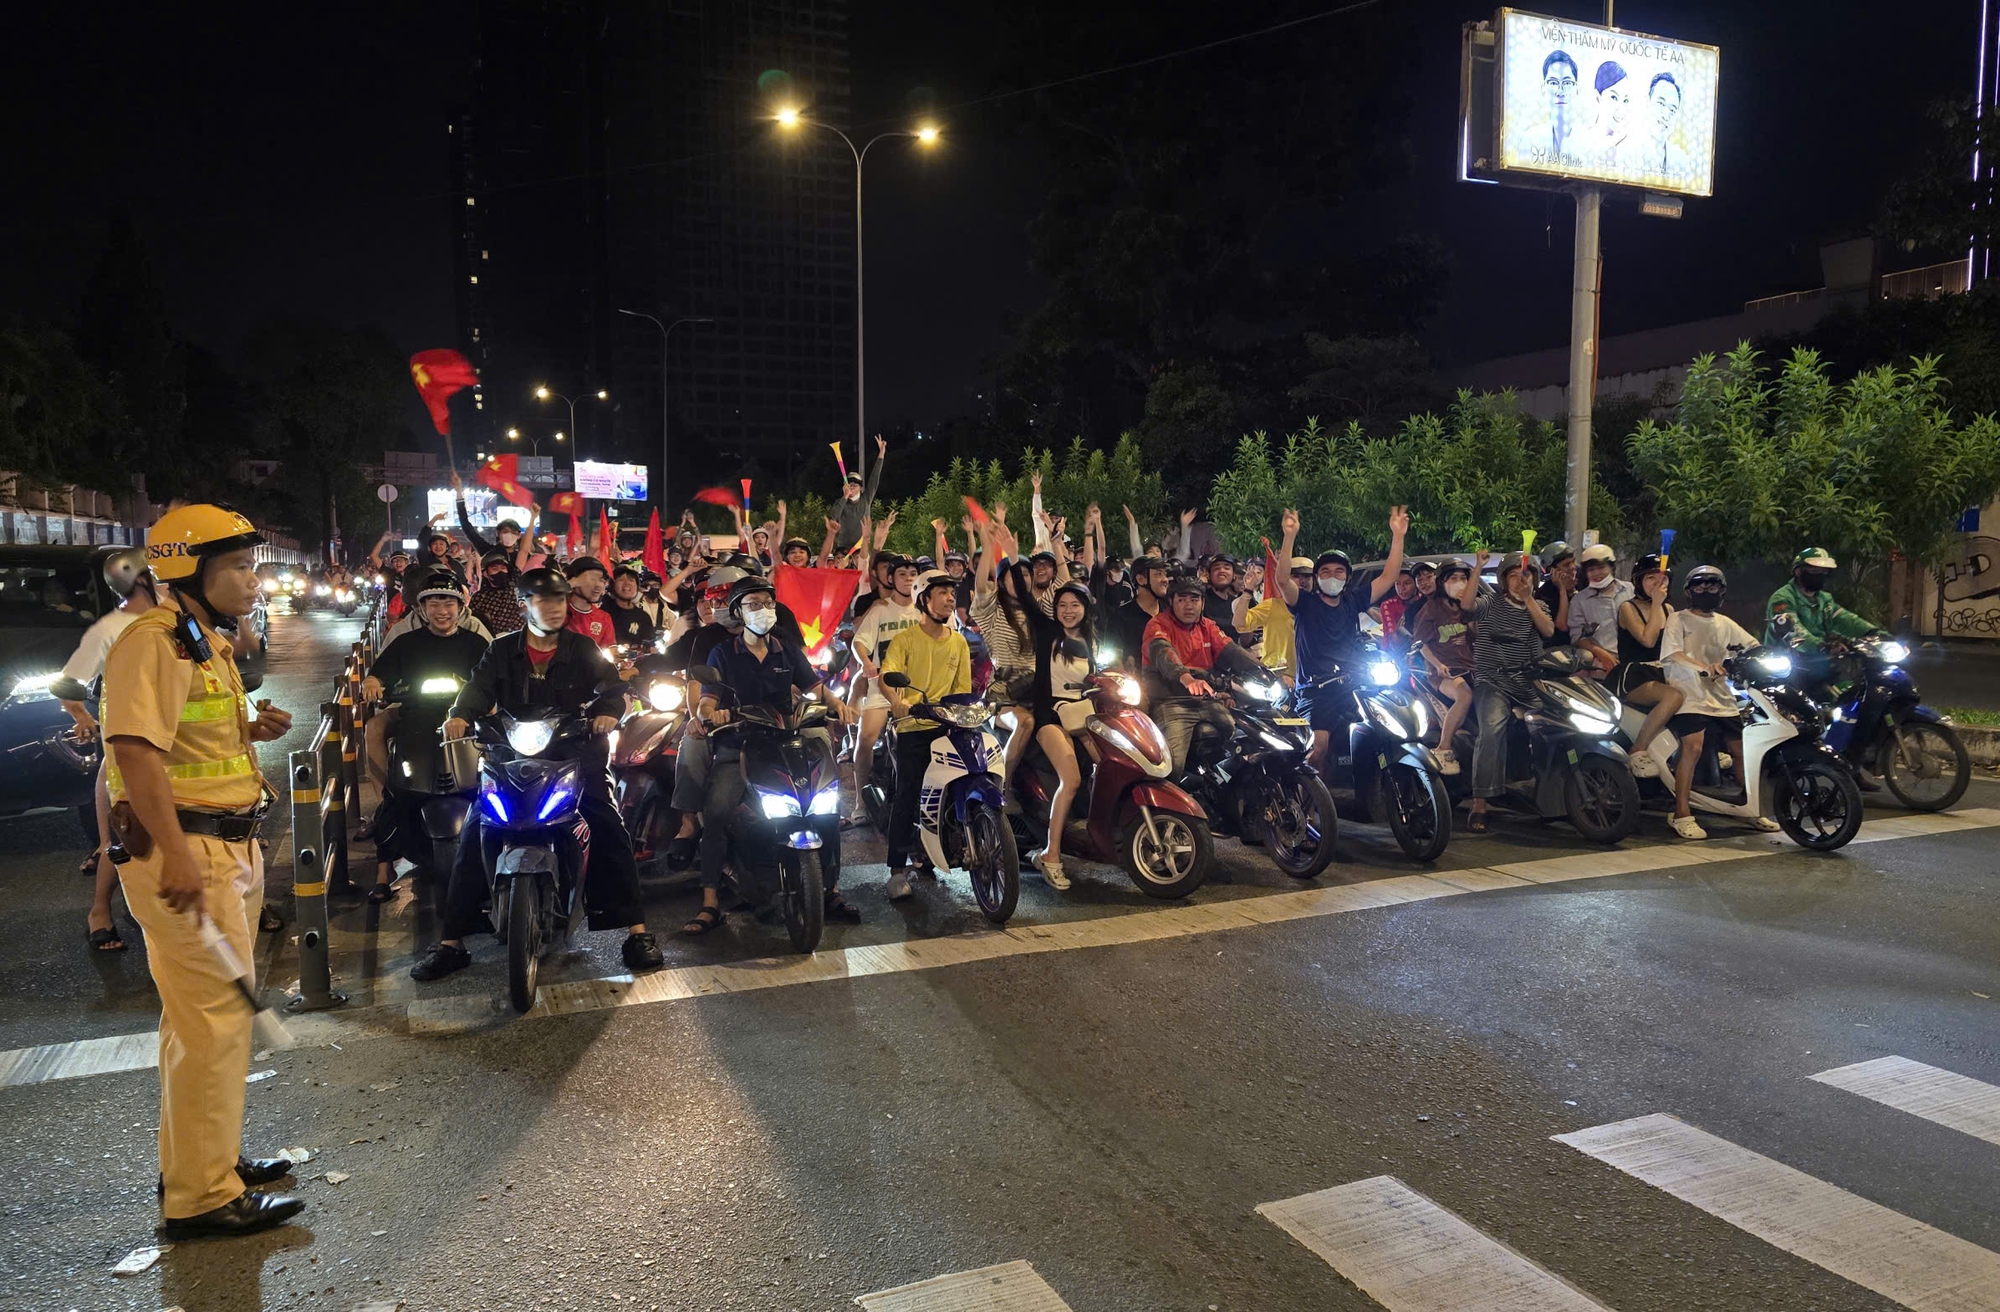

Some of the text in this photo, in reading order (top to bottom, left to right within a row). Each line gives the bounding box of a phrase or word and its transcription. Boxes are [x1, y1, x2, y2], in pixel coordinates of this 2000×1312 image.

[1541, 26, 1565, 43] VIỆN
[1619, 41, 1651, 58] QUỐC
[1655, 45, 1669, 60] TẾ
[1670, 51, 1685, 64] AA
[146, 543, 187, 560] CSGT
